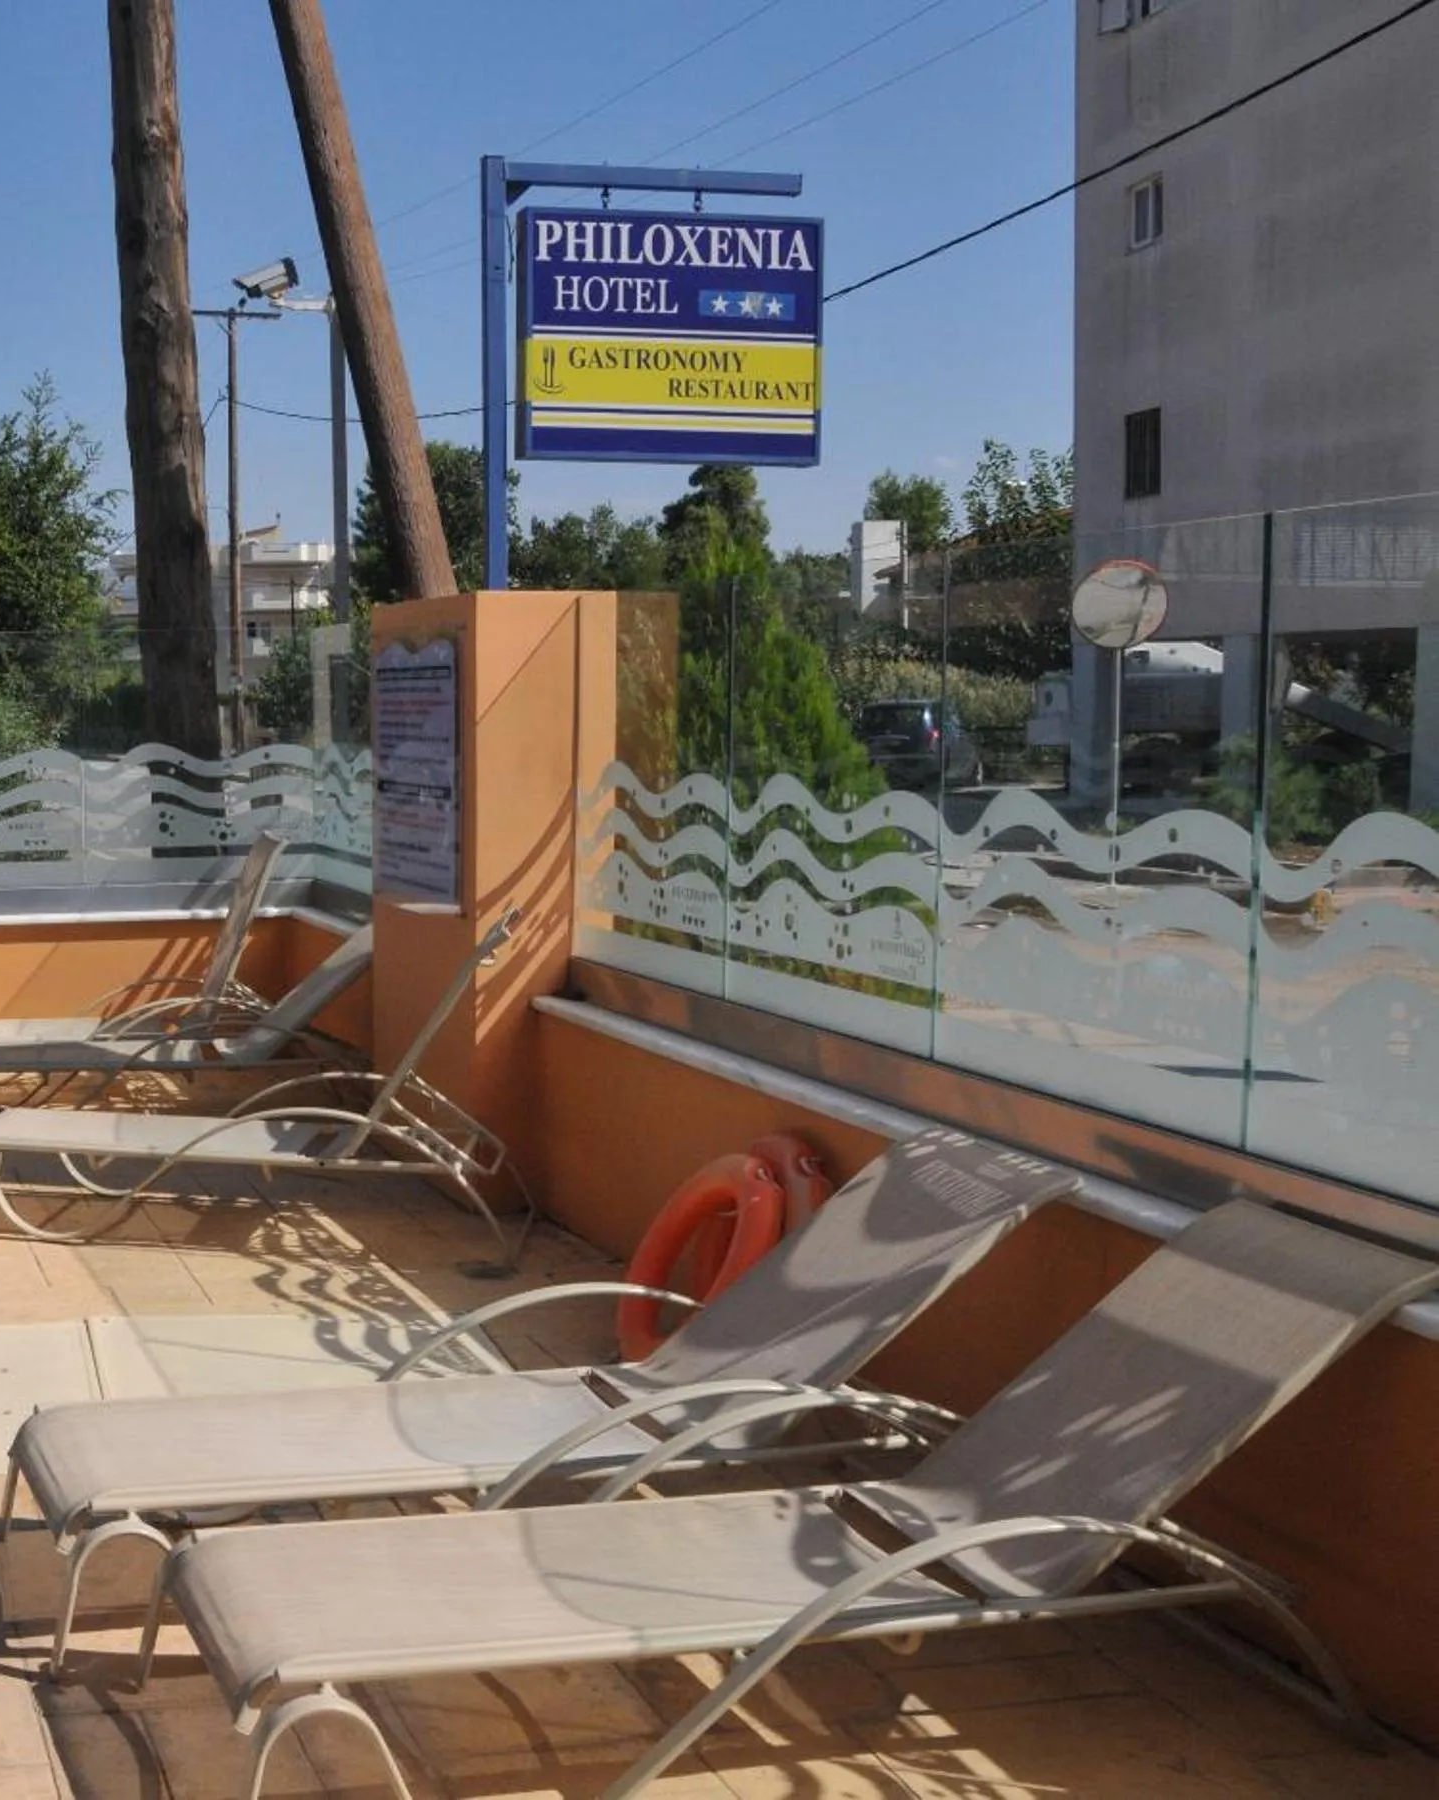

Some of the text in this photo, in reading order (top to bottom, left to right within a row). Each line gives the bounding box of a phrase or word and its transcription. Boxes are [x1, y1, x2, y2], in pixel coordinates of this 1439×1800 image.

[535, 219, 814, 271] PHILOXENIA
[553, 275, 679, 315] HOTEL
[568, 345, 748, 374] GASTRONOMY
[668, 378, 816, 402] RESTAURANT
